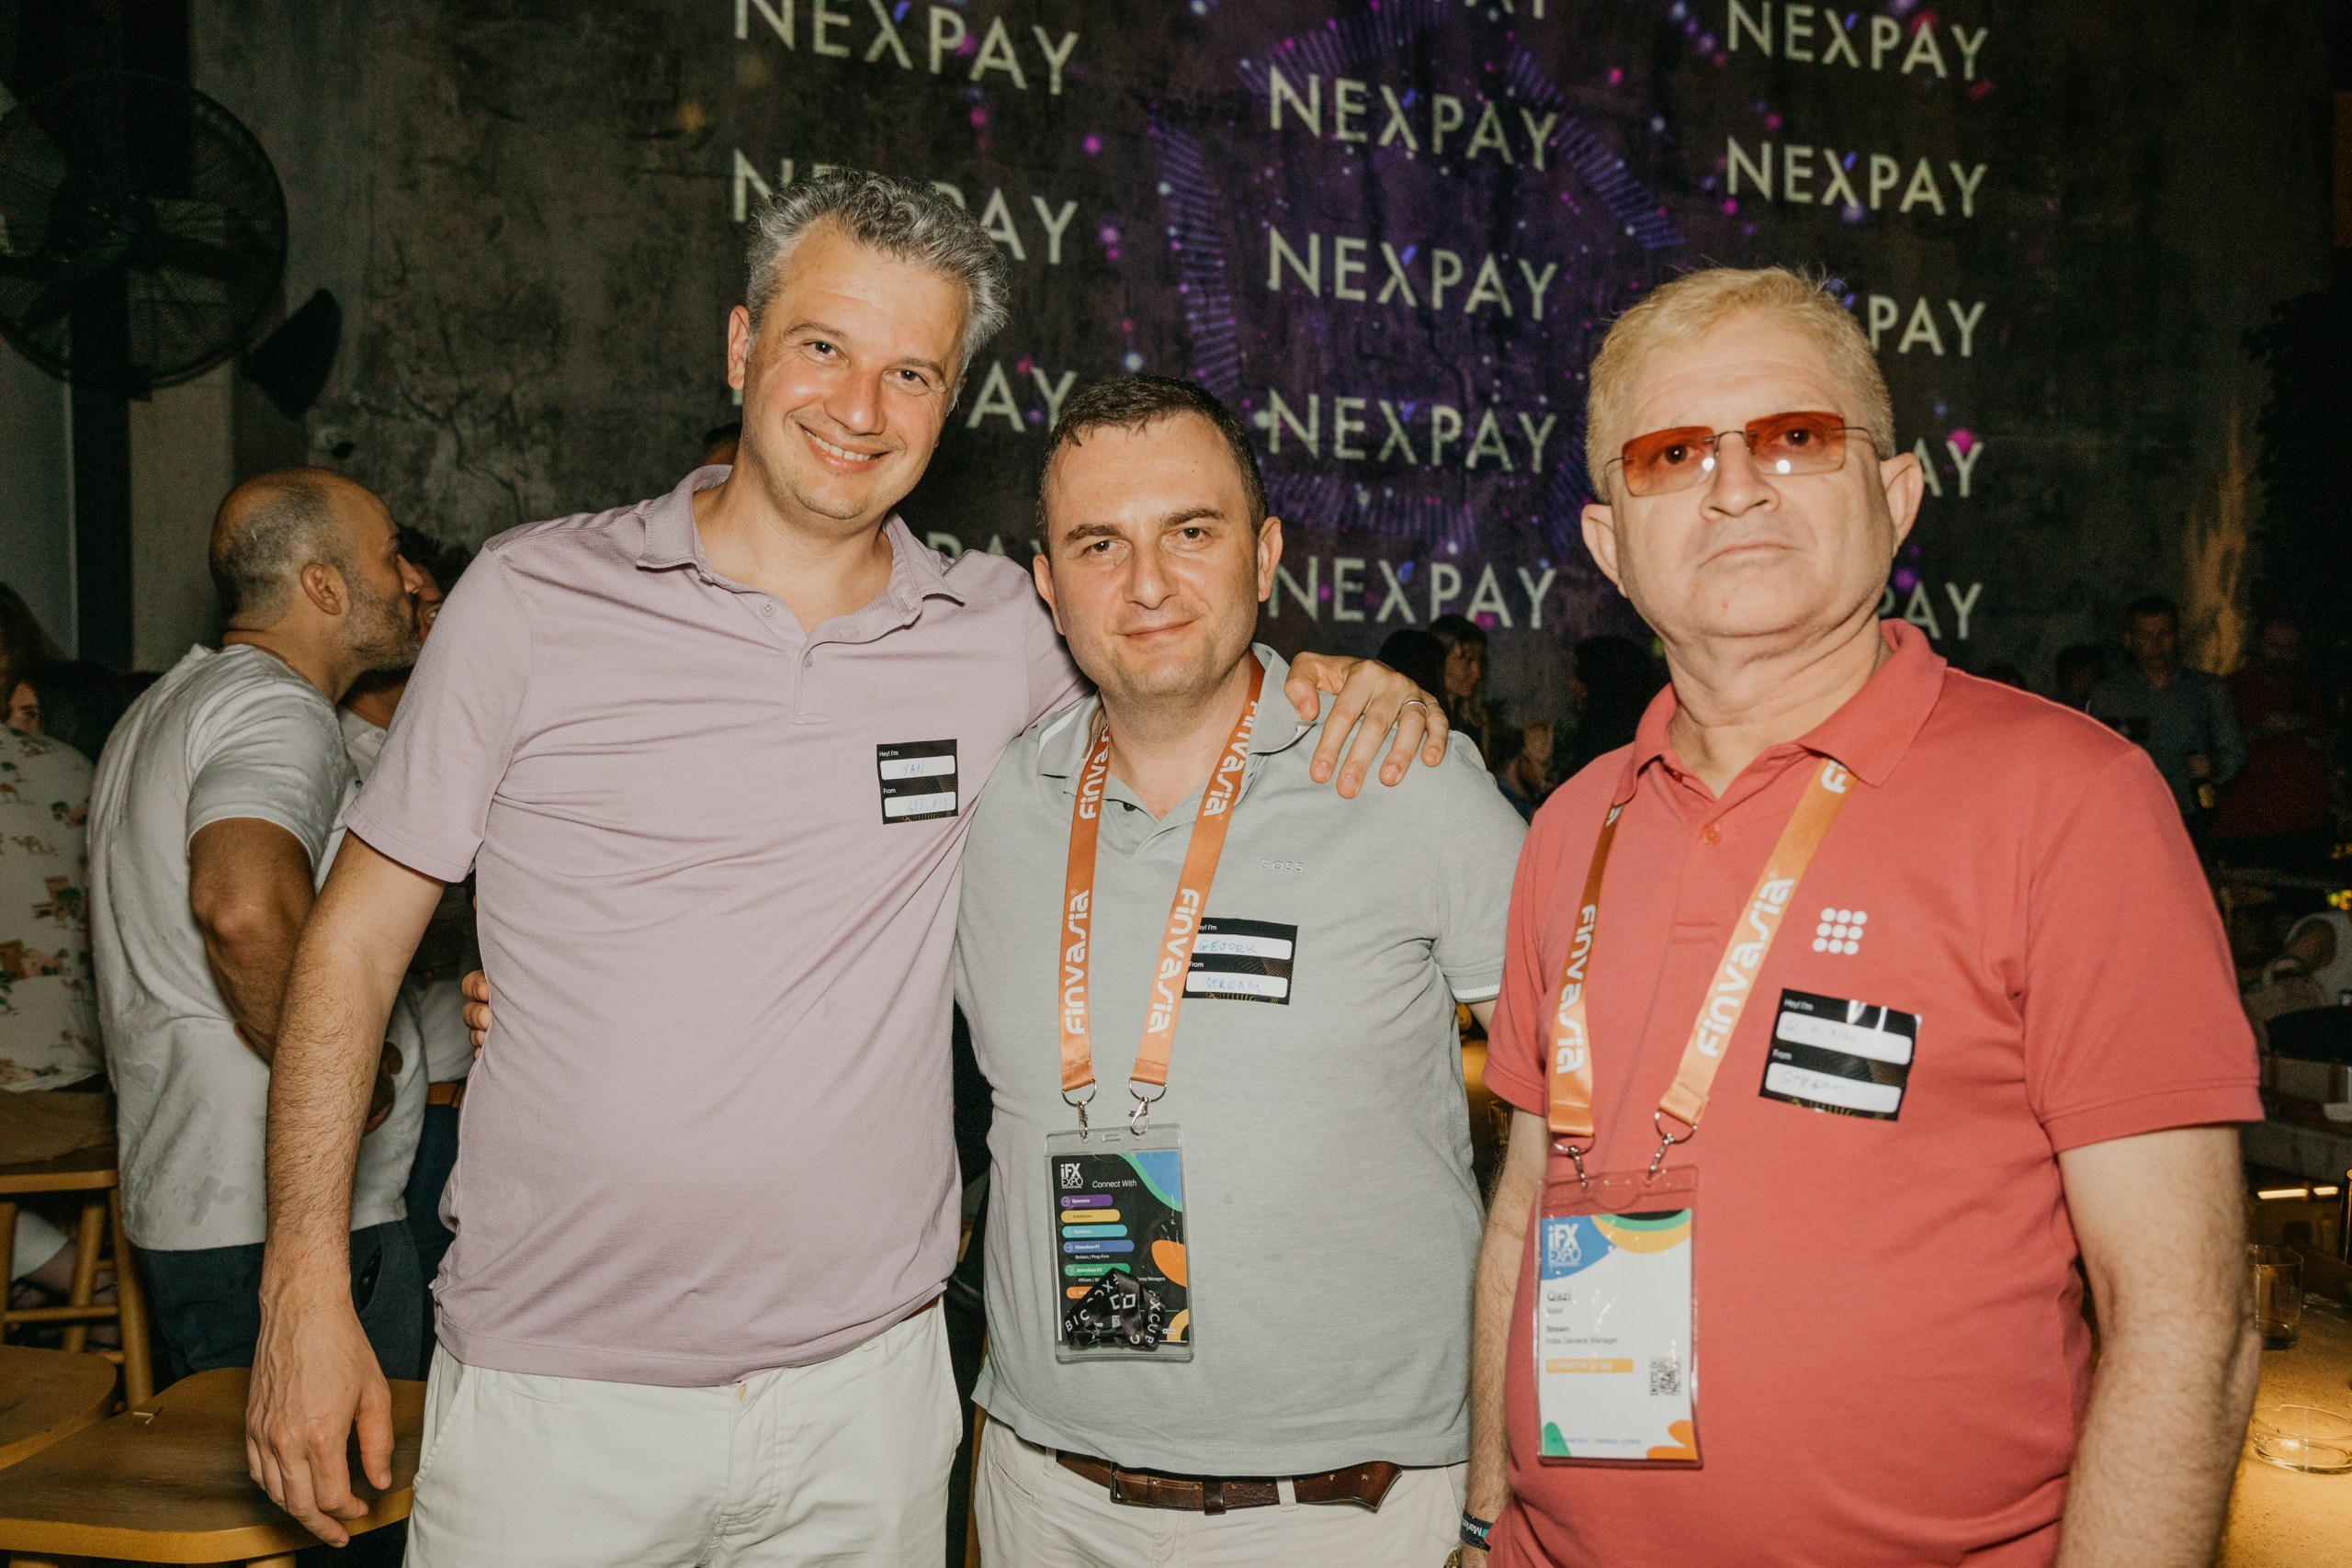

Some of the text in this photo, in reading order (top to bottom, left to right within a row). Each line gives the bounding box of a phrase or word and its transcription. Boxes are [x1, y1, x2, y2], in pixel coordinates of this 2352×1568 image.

[735, 0, 1079, 96] NEXPAY
[1726, 0, 1989, 81] NEXPAY
[1271, 65, 1558, 172] NEXPAY
[1727, 135, 1987, 218] NEXPAY
[1268, 226, 1558, 321] NEXPAY
[1269, 388, 1557, 474] NEXPAY
[1268, 555, 1557, 629] NEXPAY
[1261, 859, 1303, 872] BOSS
[1061, 1177, 1083, 1187] EXPO
[1092, 1179, 1137, 1189] Connect With
